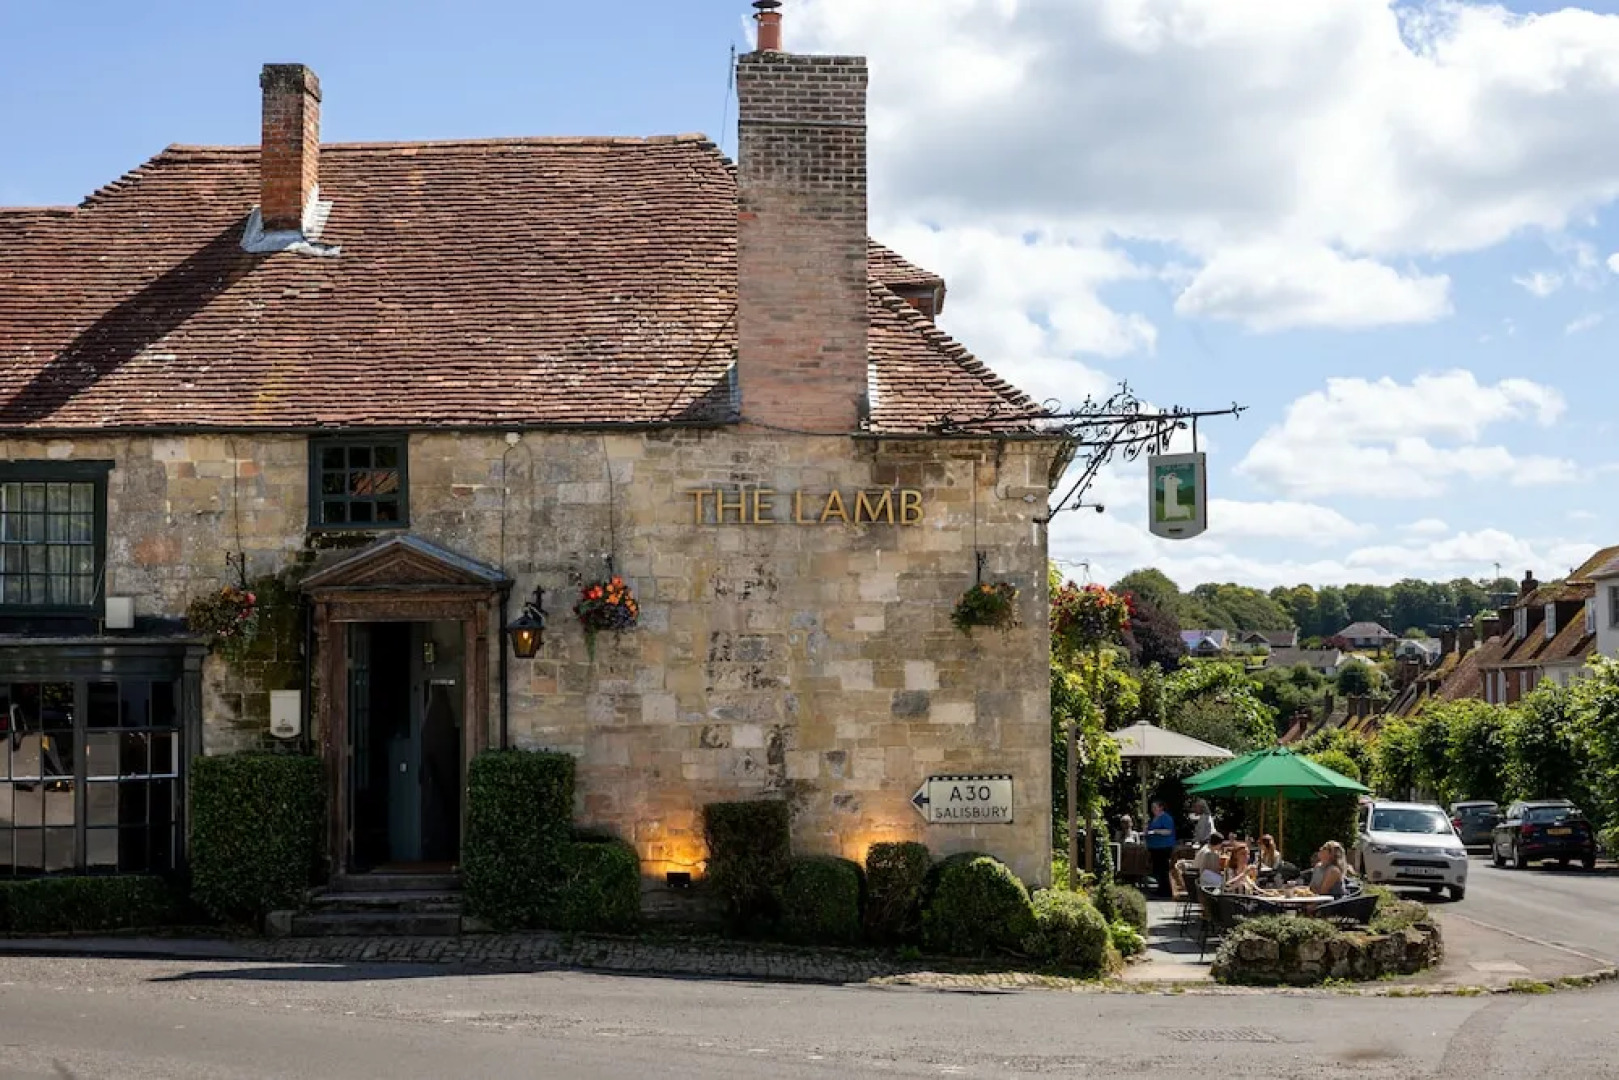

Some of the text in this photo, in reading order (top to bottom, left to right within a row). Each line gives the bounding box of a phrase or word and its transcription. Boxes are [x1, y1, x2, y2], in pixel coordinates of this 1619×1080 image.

[686, 488, 925, 525] THE LAMB
[949, 784, 991, 802] A30
[935, 805, 1008, 819] SALISBURY
